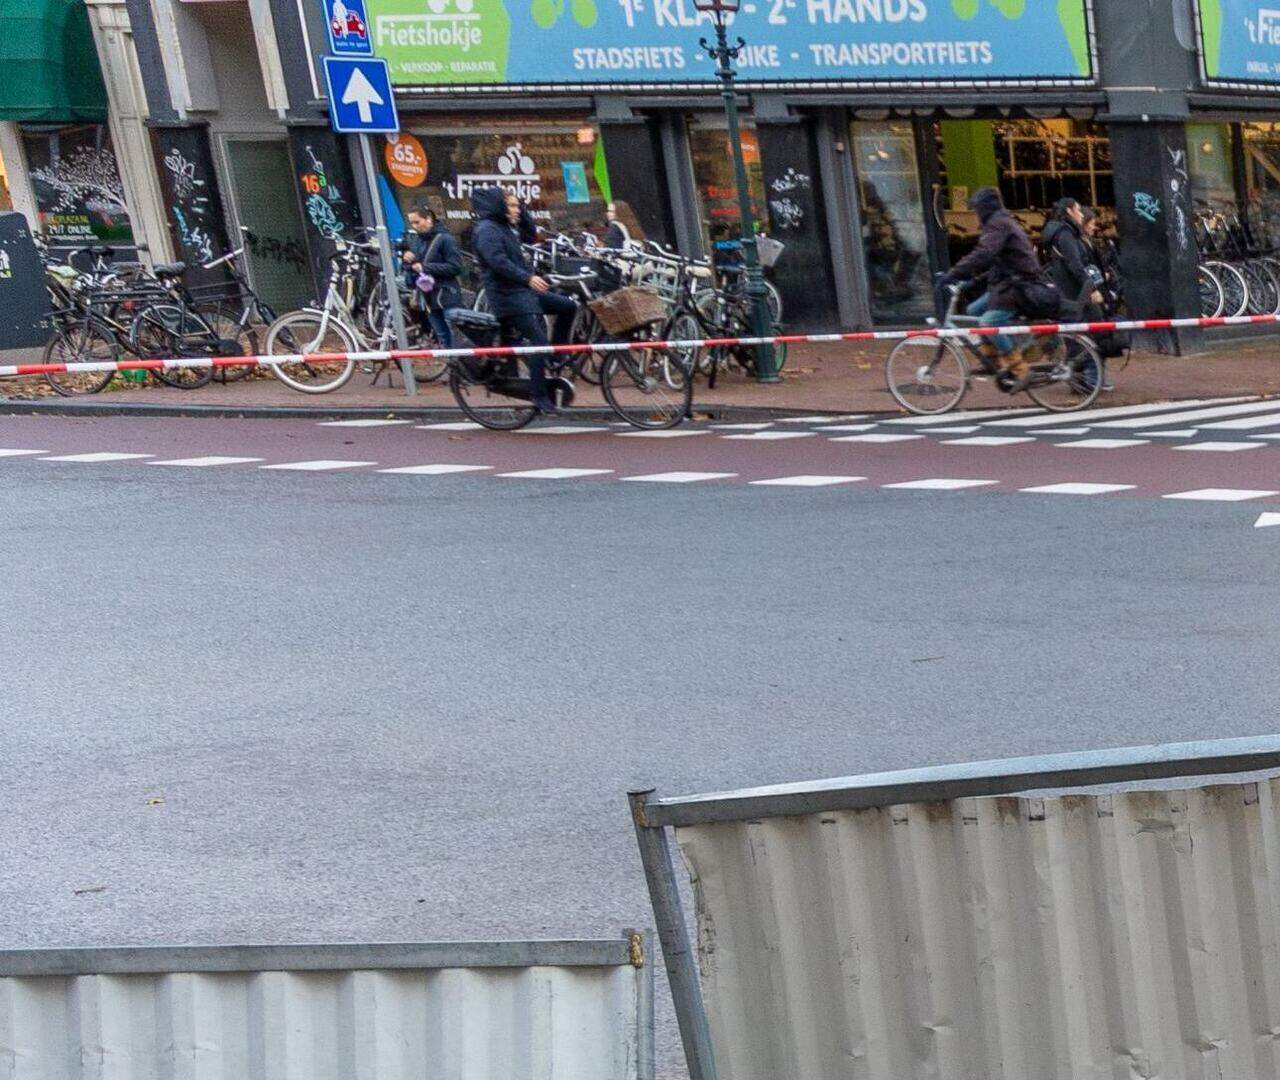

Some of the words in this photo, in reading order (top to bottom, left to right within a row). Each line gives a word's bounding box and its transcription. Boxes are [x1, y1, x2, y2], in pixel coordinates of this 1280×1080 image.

[376, 13, 482, 52] Fietshokje
[572, 47, 686, 70] STADSFIETS
[809, 41, 993, 66] TRANSPORTFIETS
